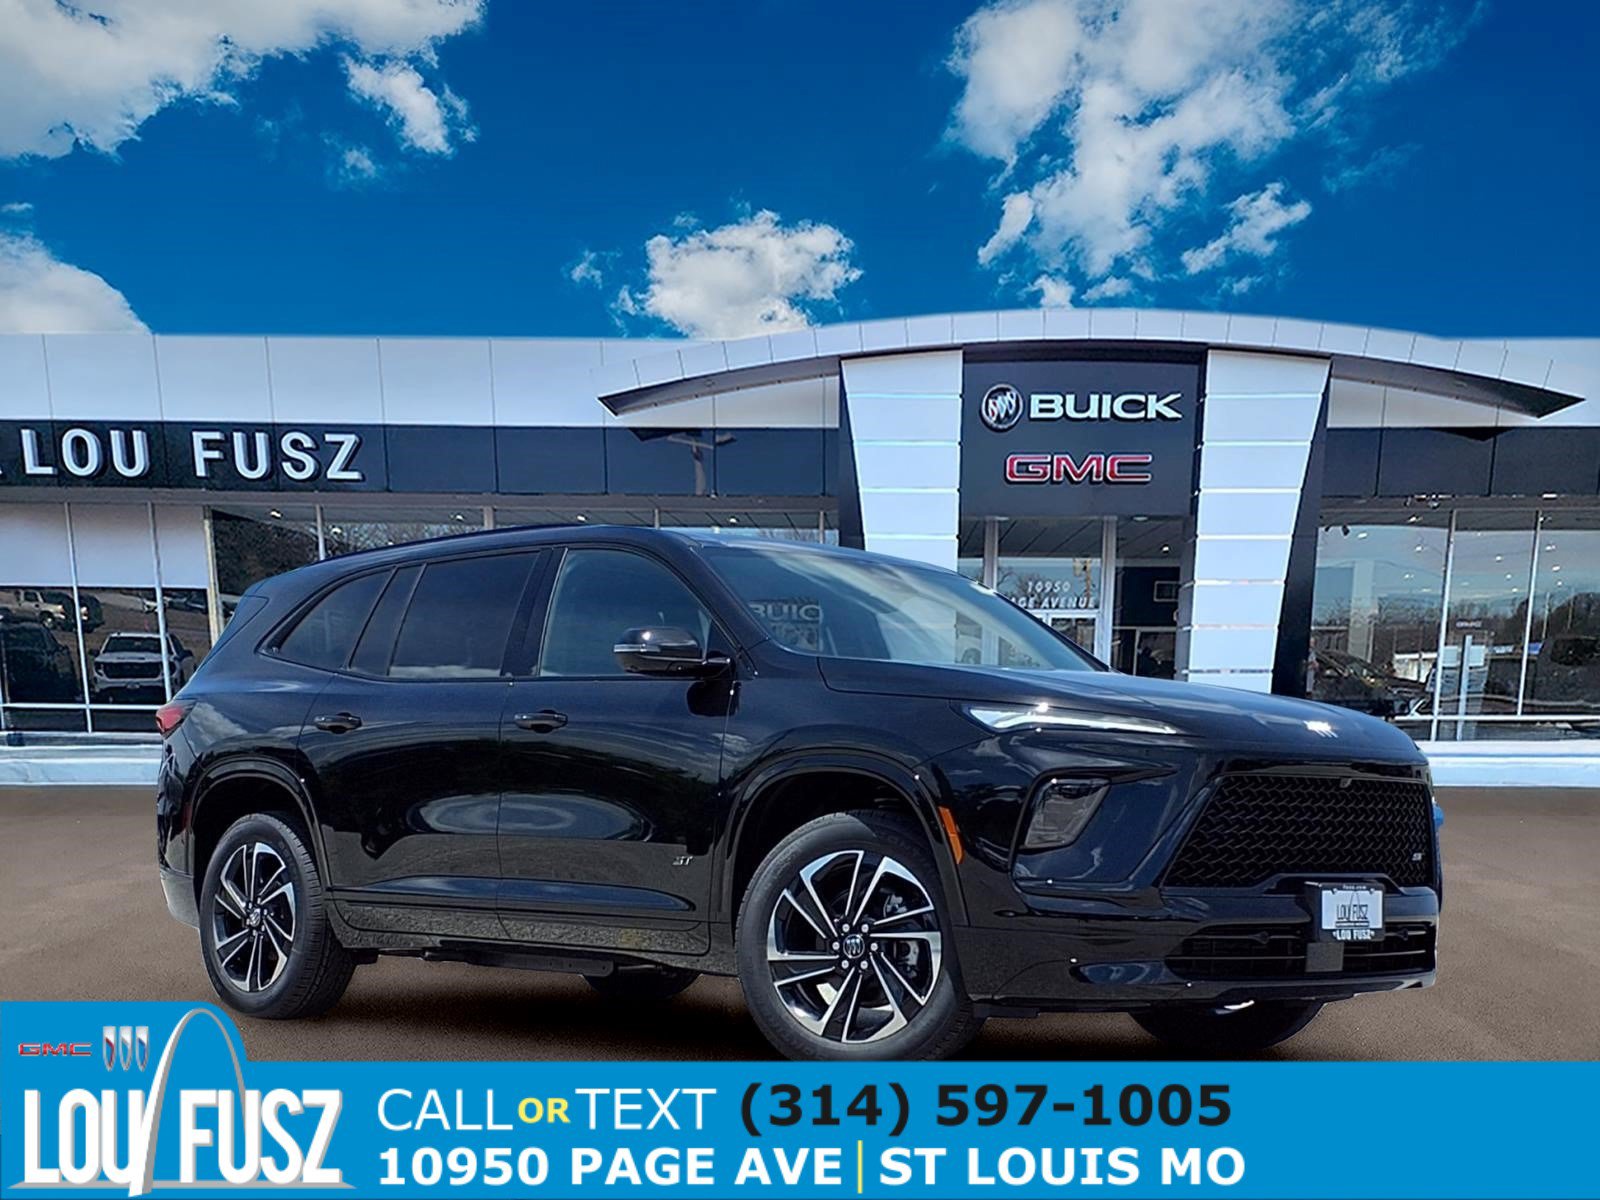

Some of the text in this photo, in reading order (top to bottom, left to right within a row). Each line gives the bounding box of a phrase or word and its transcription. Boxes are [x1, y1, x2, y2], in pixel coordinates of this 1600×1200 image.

[1029, 393, 1182, 420] BUICK
[20, 428, 363, 480] LOU FUSZ
[1005, 454, 1152, 482] GMC
[1027, 580, 1072, 593] 10950
[1040, 596, 1096, 609] AVENUE
